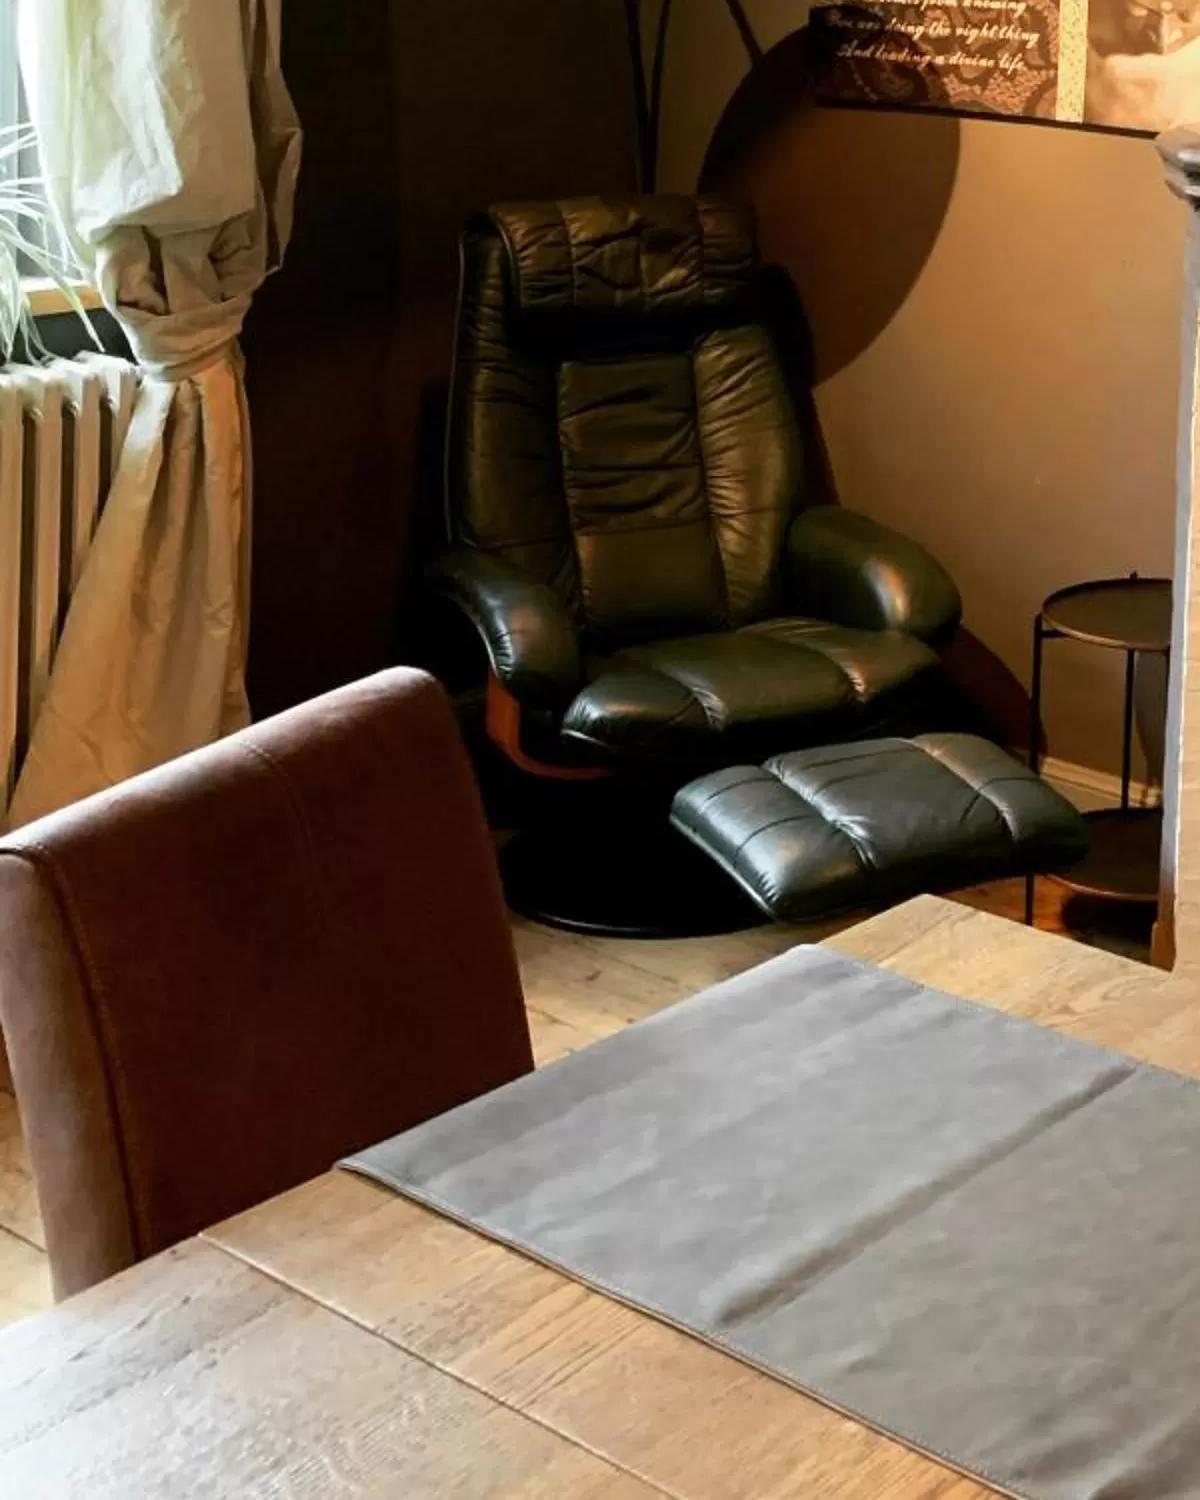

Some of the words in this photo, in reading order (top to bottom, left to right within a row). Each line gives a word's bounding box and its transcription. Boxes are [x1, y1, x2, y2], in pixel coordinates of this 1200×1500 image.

[928, 20, 951, 37] the
[955, 22, 999, 45] right
[998, 23, 1040, 49] thing
[836, 40, 875, 57] And
[934, 54, 945, 64] a
[949, 51, 995, 68] divine
